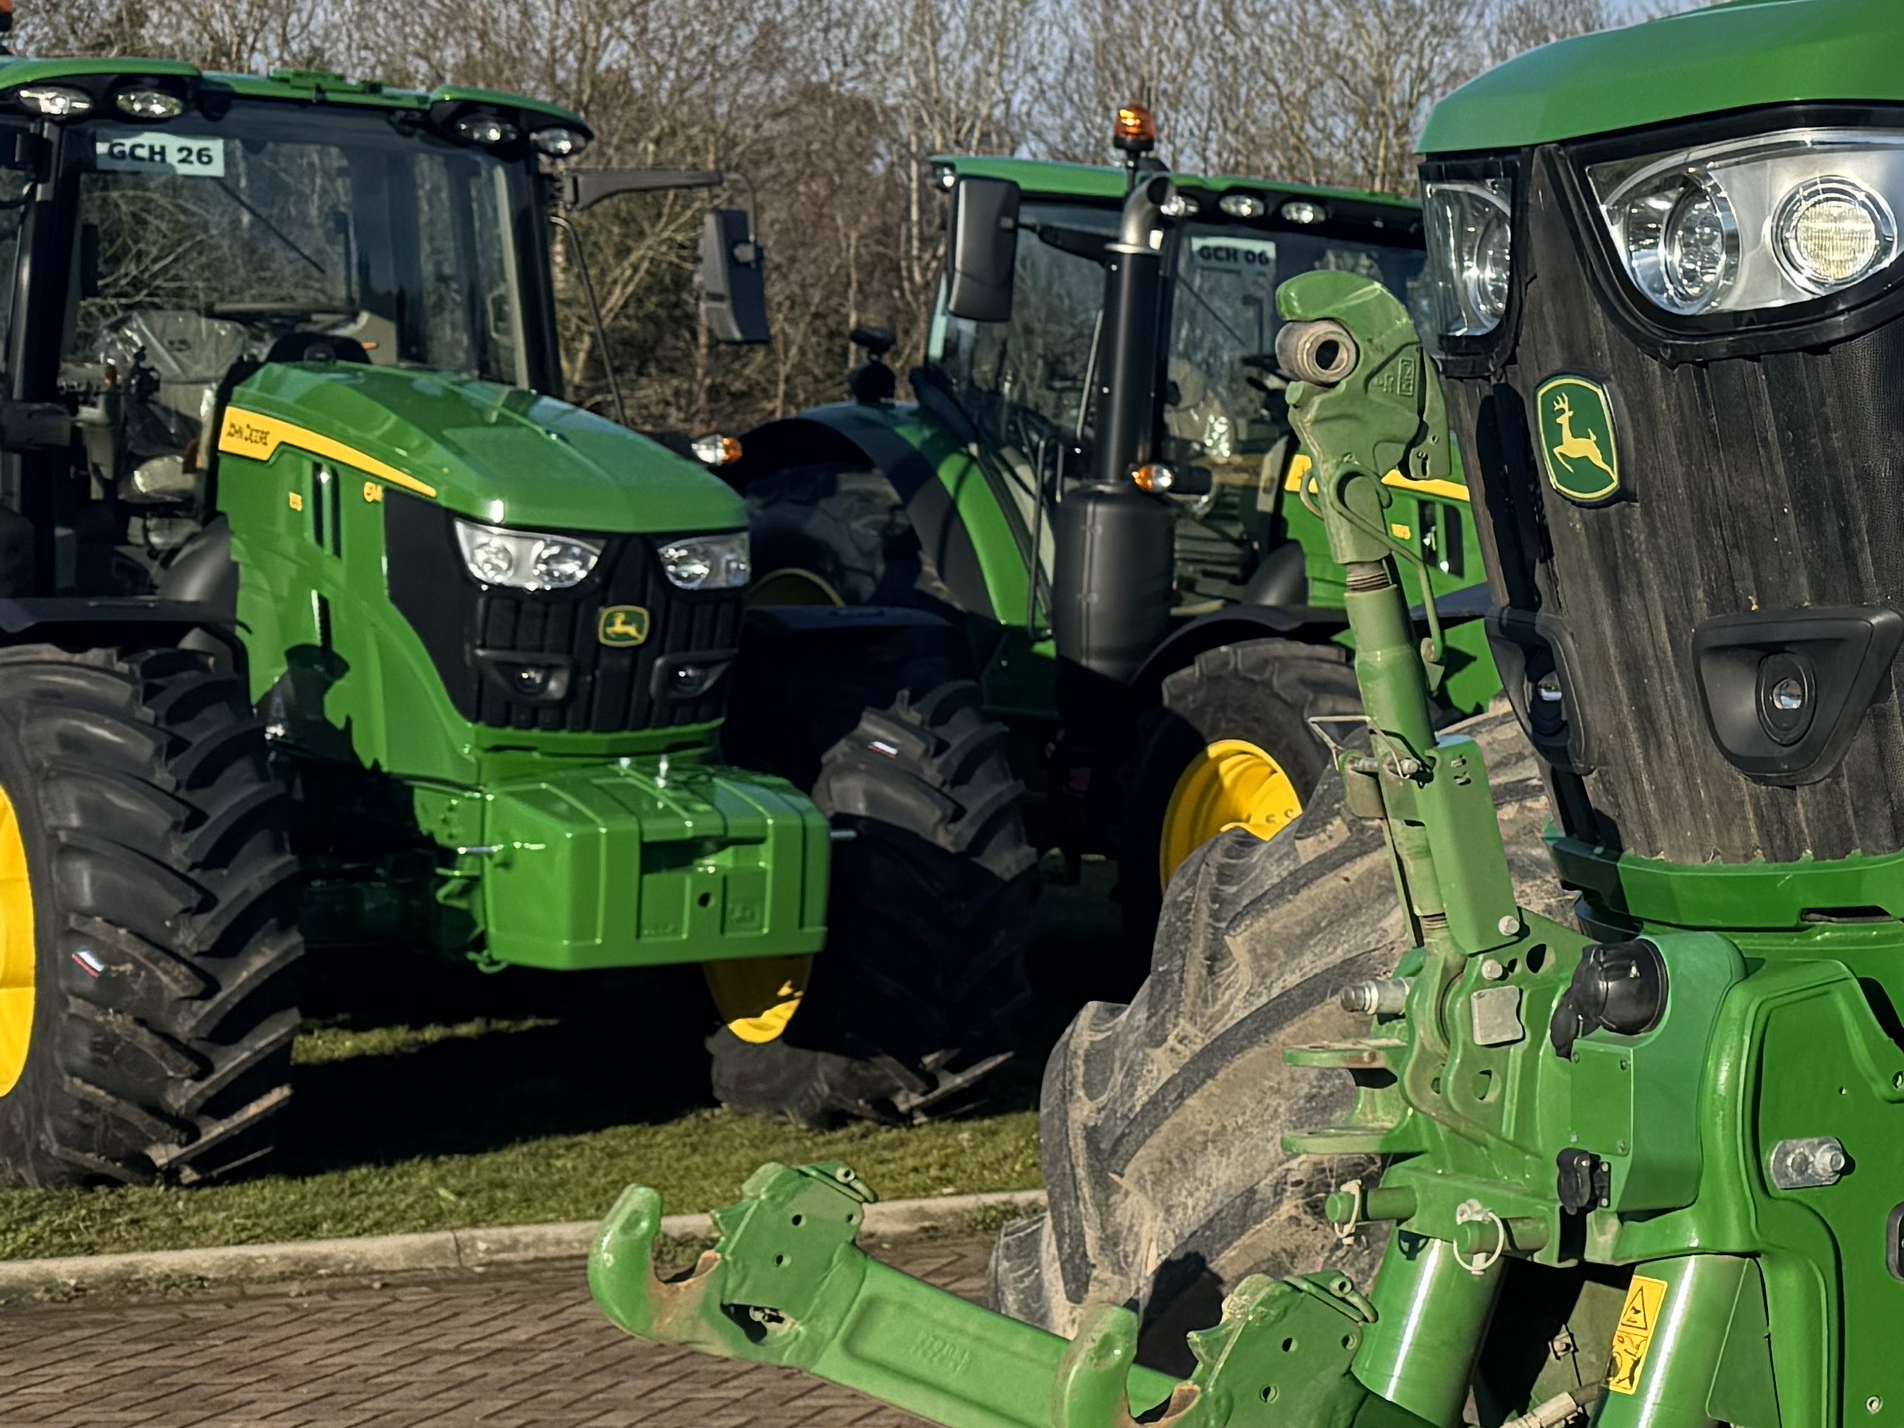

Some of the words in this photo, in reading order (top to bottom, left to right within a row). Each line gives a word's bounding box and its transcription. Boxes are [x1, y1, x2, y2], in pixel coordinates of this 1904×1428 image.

[107, 141, 167, 164] GCH
[176, 145, 214, 166] 26
[1199, 245, 1239, 263] GCH
